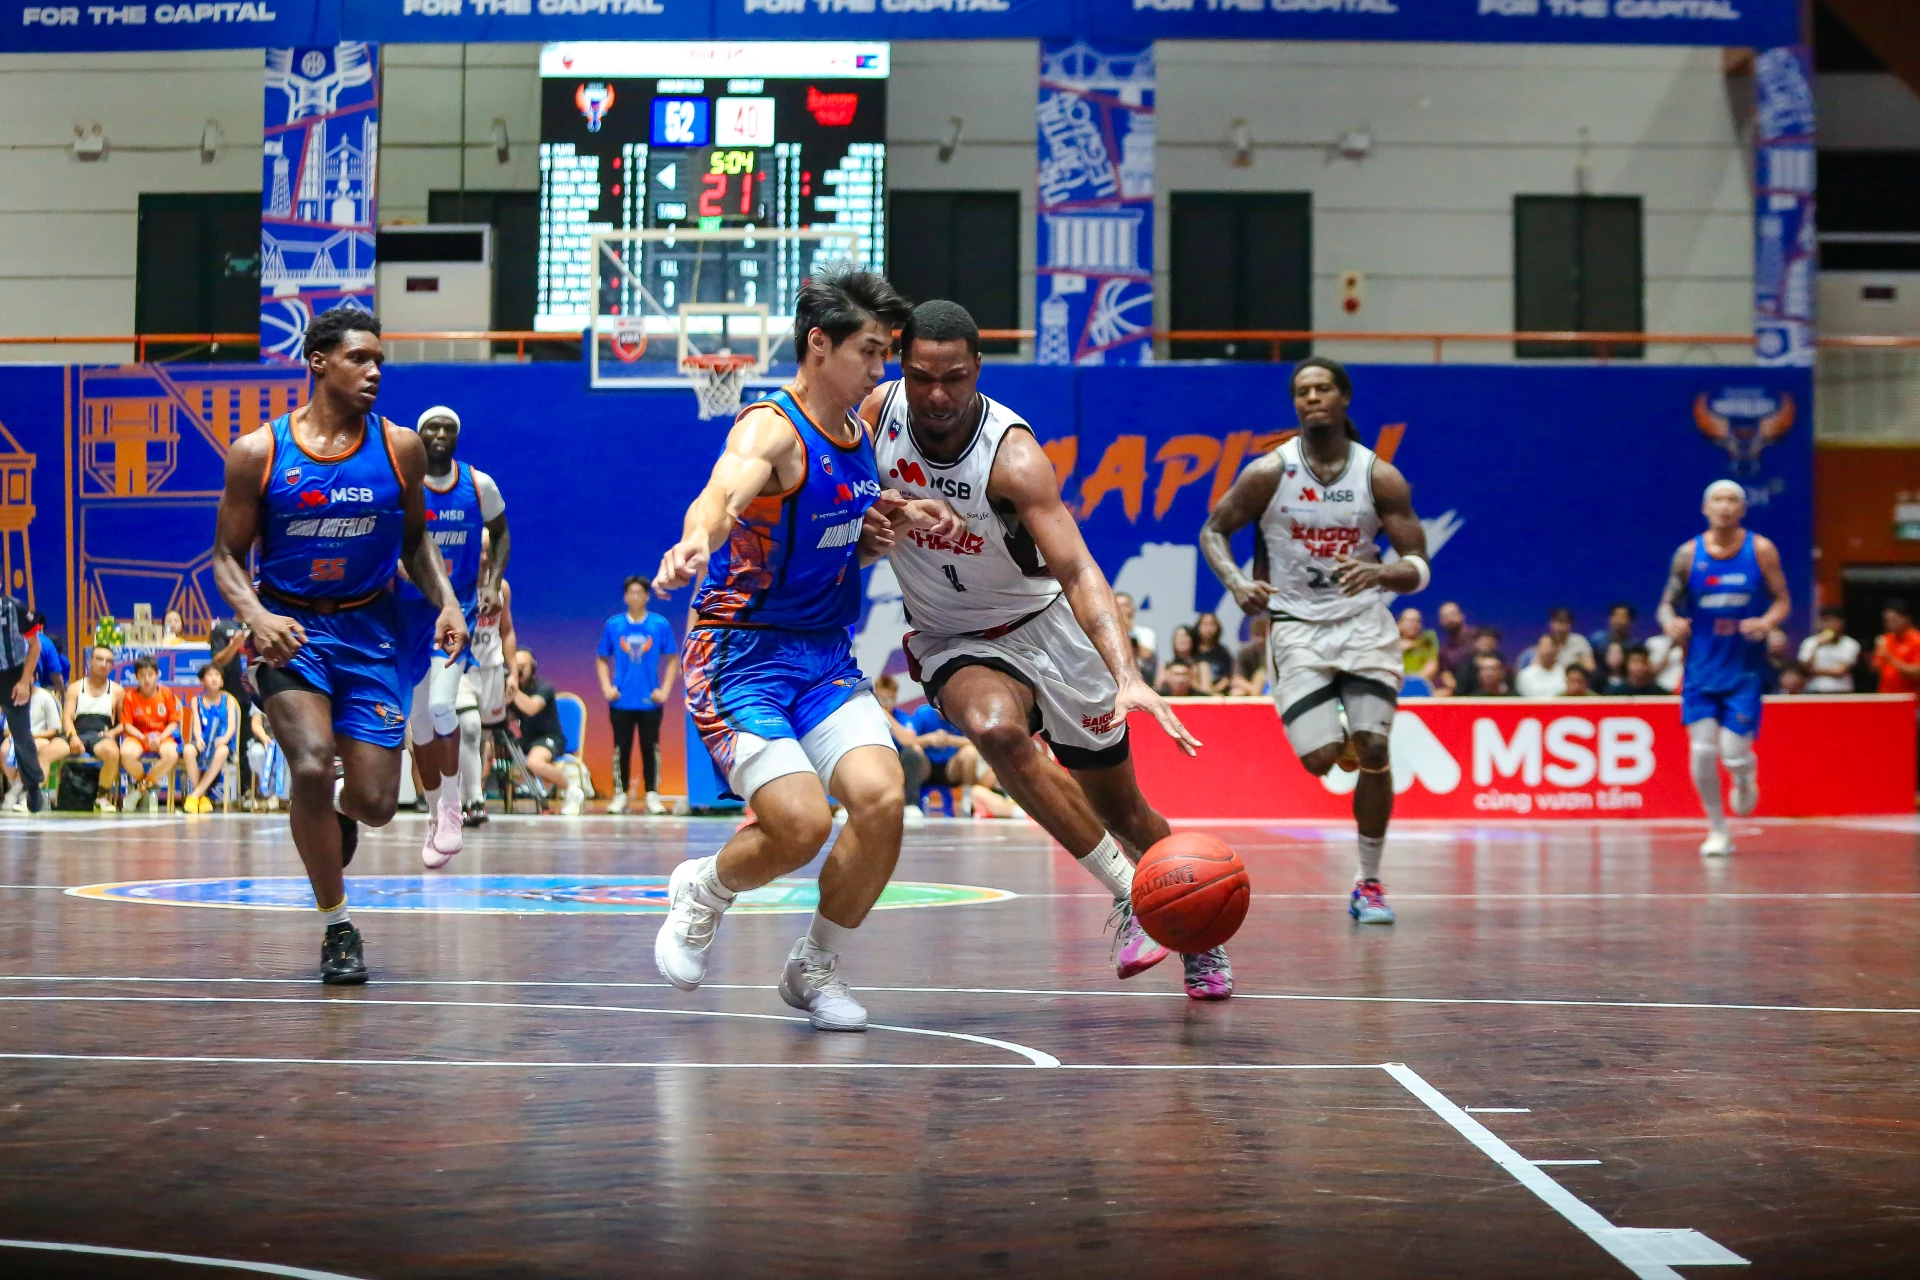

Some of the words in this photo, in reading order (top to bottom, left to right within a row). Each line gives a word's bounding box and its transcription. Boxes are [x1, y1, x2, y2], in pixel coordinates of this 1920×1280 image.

[23, 7, 80, 26] FOR
[87, 5, 147, 25] THE
[154, 1, 277, 24] CAPITAL
[403, 0, 462, 16] FOR
[469, 0, 532, 15] THE
[537, 0, 665, 15] CAPITAL
[664, 101, 696, 143] 52
[733, 105, 759, 139] 40
[710, 150, 754, 175] 5:04
[699, 172, 753, 216] 21
[330, 487, 374, 503] MSB
[929, 476, 972, 500] MSB
[1322, 489, 1355, 503] MSB
[439, 509, 465, 521] MSB
[311, 558, 347, 581] 55
[1081, 708, 1116, 728] SAIGO
[1472, 716, 1656, 787] MSB
